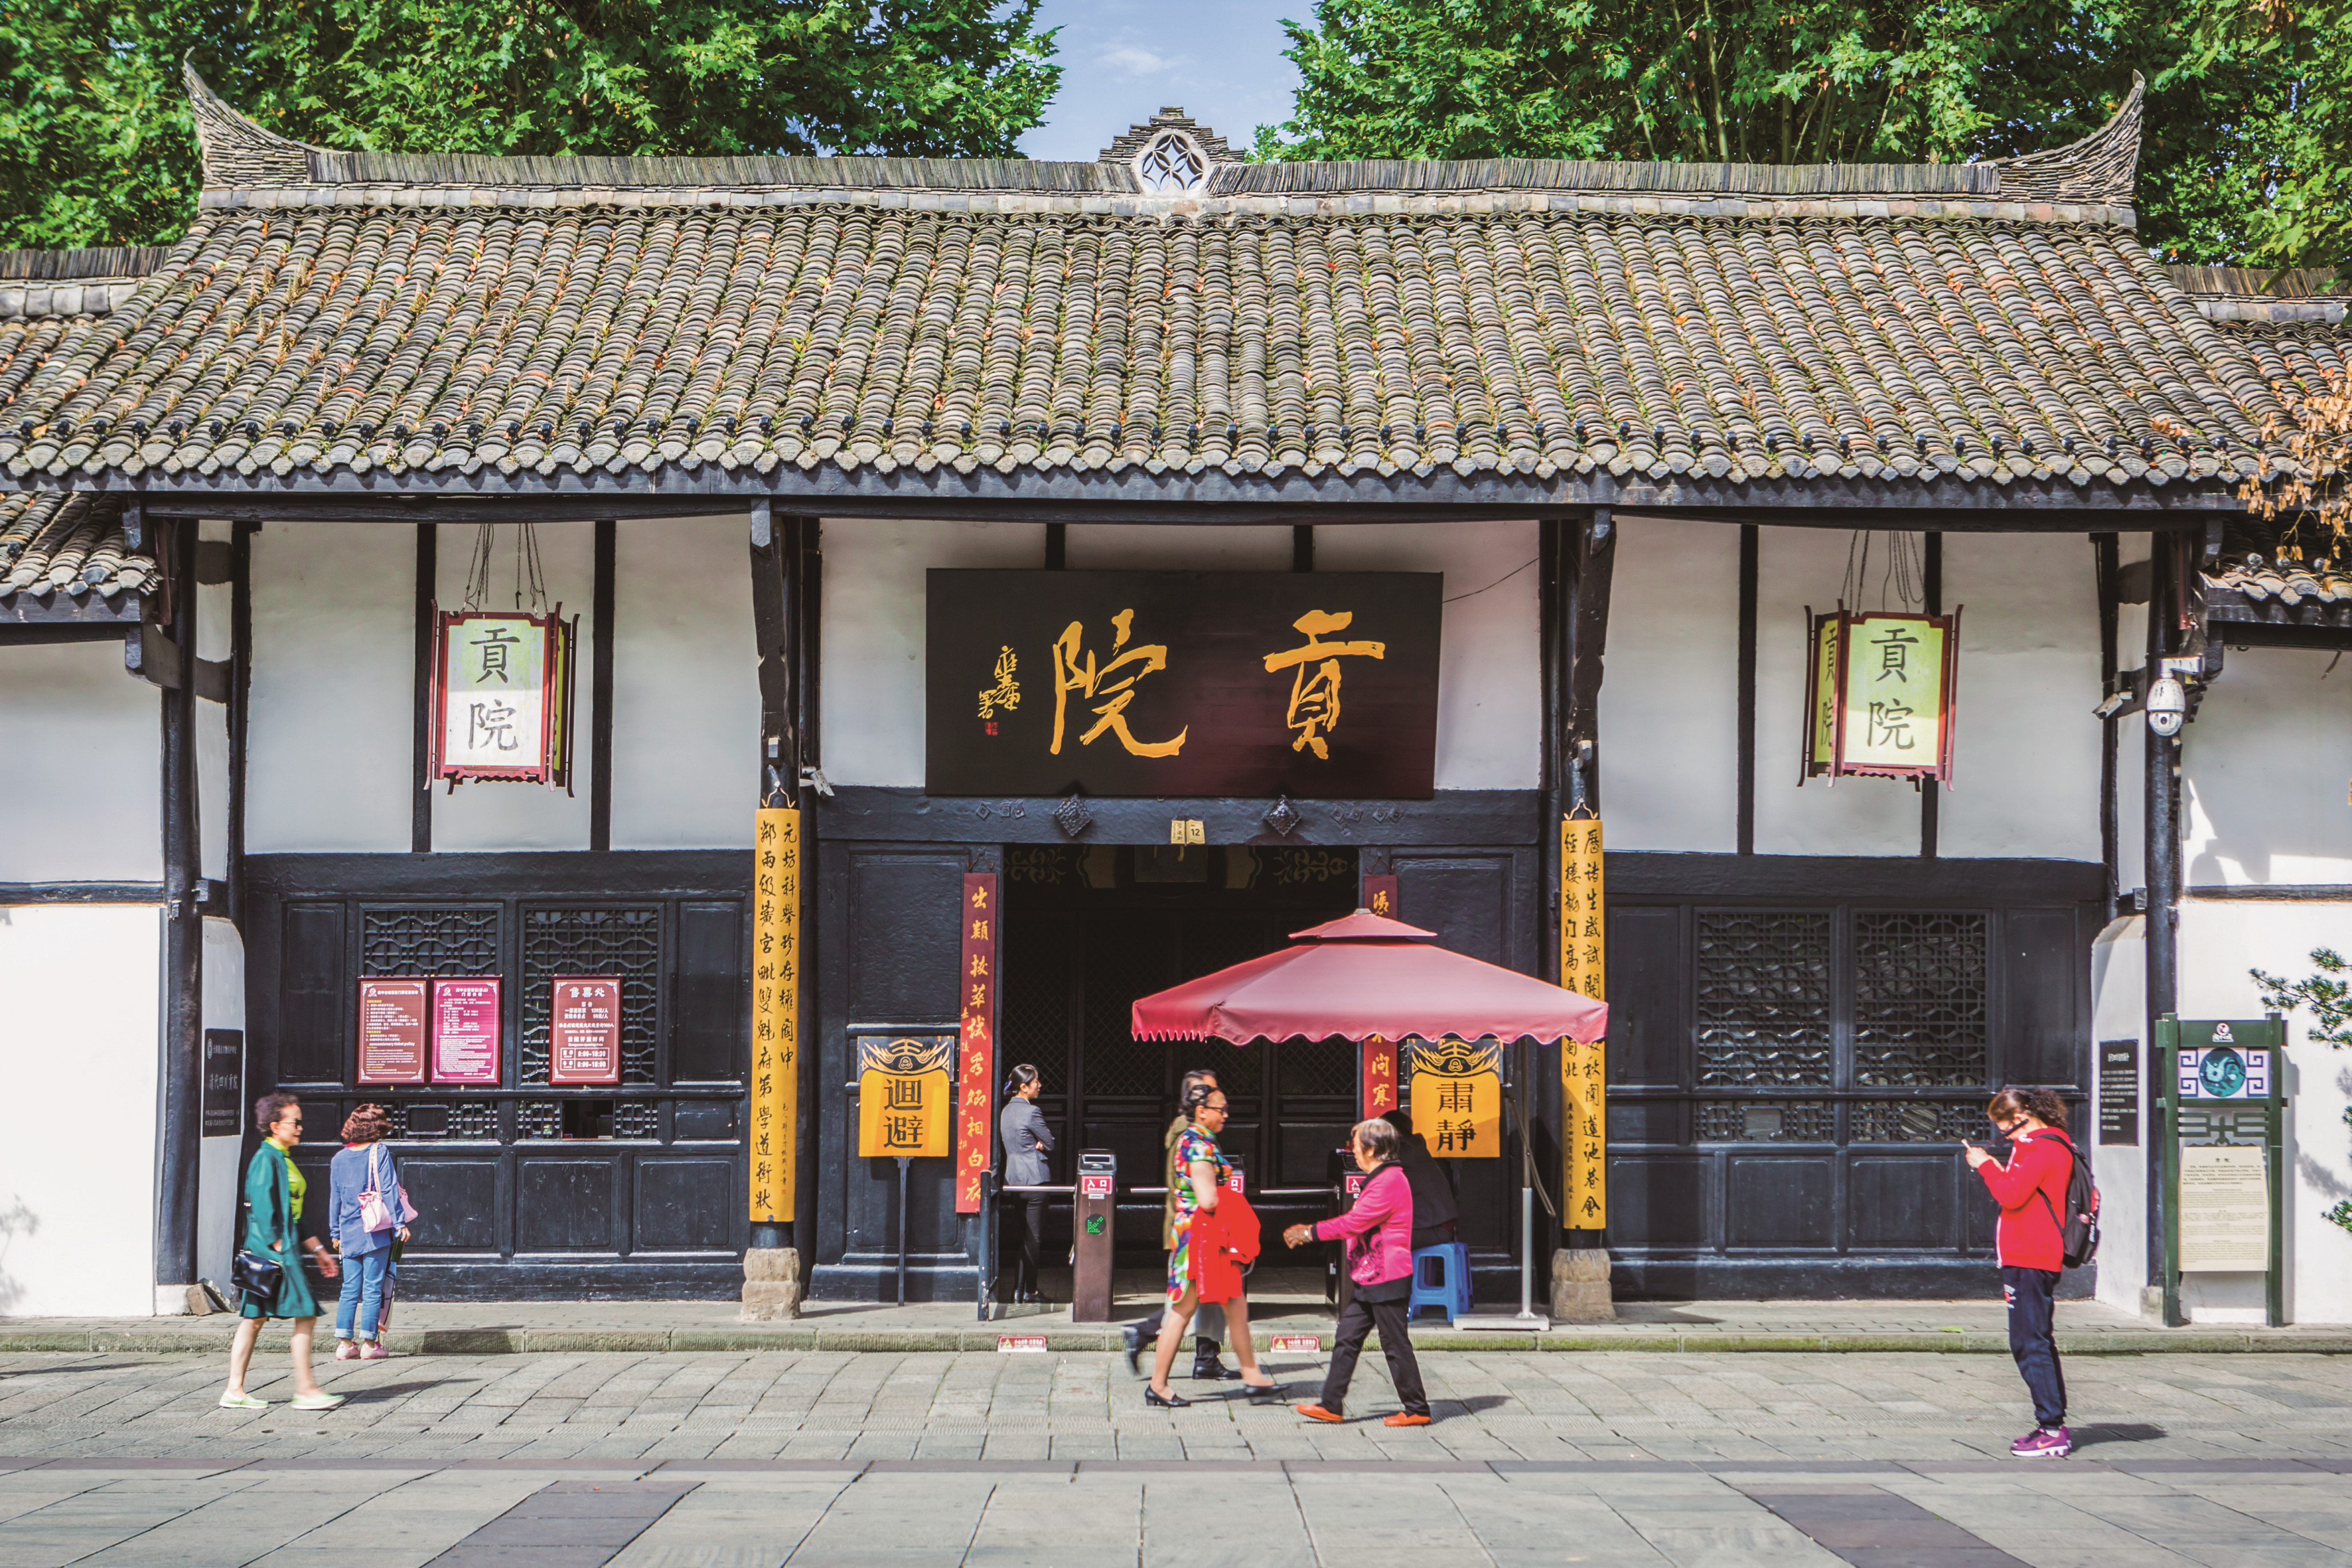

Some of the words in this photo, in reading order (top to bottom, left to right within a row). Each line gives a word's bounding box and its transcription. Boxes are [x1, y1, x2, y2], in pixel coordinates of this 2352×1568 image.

[468, 628, 520, 751] 貢院
[1867, 628, 1919, 750] 貢院
[570, 987, 605, 998] 售票处
[883, 1078, 923, 1148] 迴避
[1436, 1081, 1477, 1151] 肅靜
